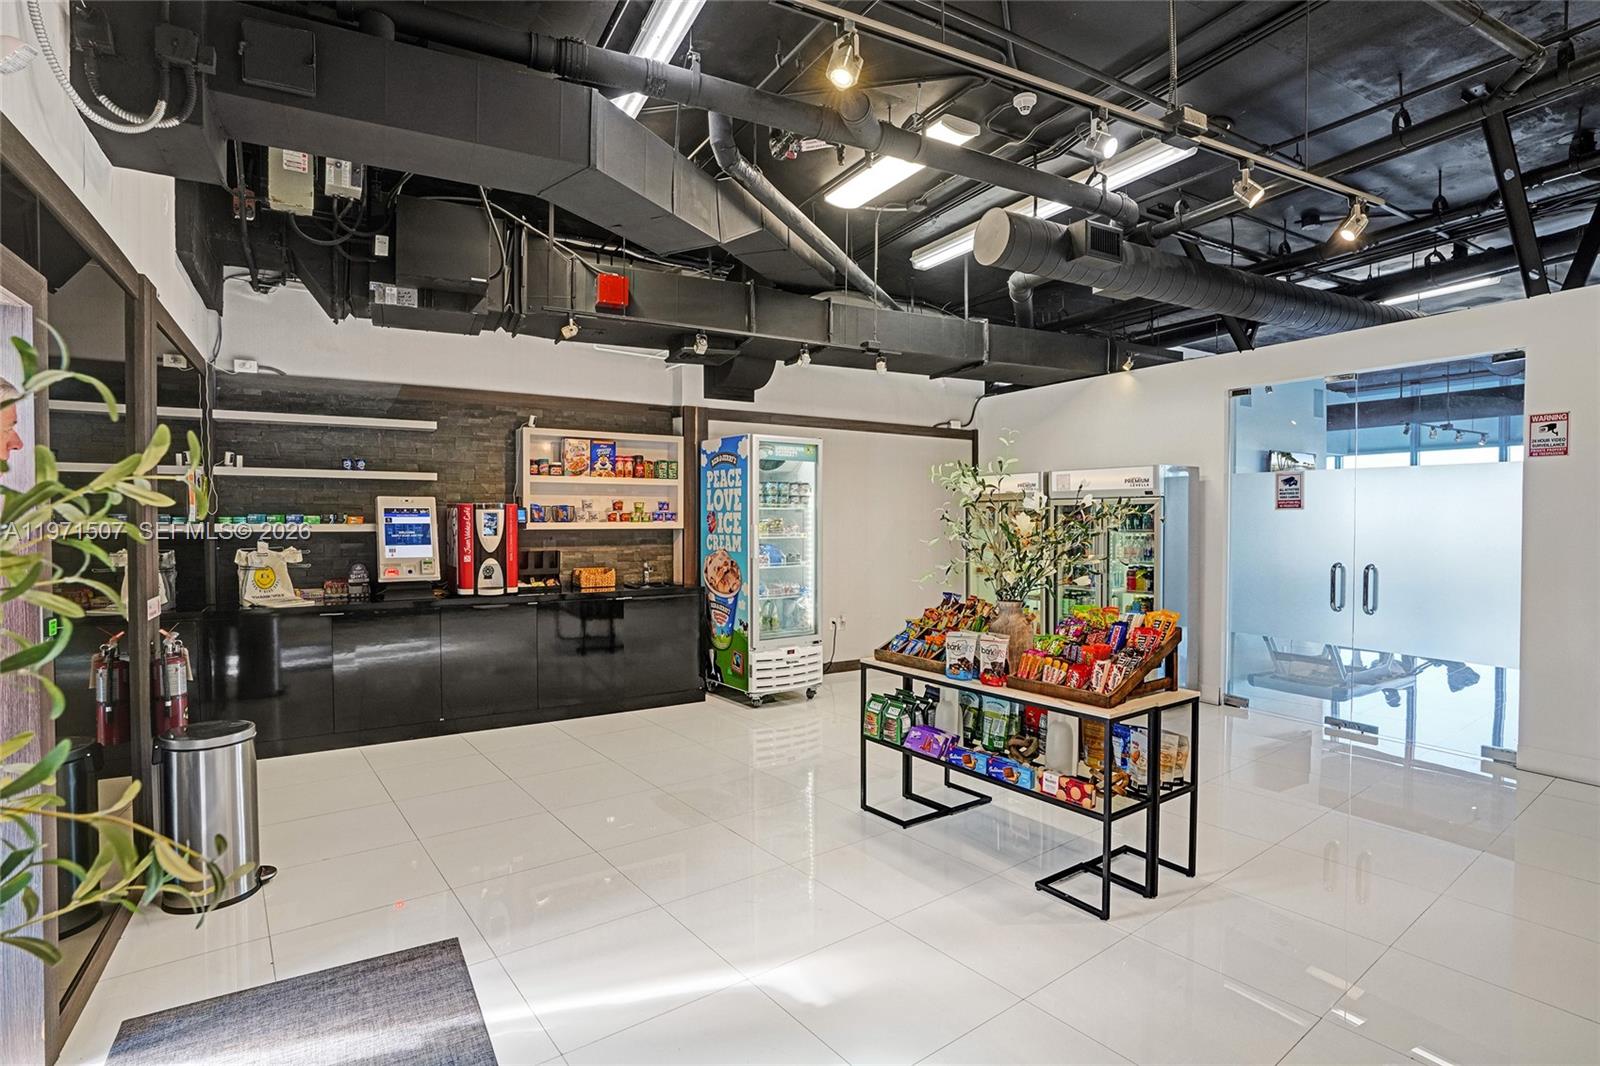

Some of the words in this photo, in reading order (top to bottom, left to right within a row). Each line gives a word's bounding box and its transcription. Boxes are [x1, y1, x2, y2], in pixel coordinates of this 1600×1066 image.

[1532, 414, 1568, 422] WARNING
[706, 468, 742, 488] PEACE
[706, 488, 742, 512] LOVE
[717, 512, 742, 534] ICE
[706, 534, 742, 552] CREAM
